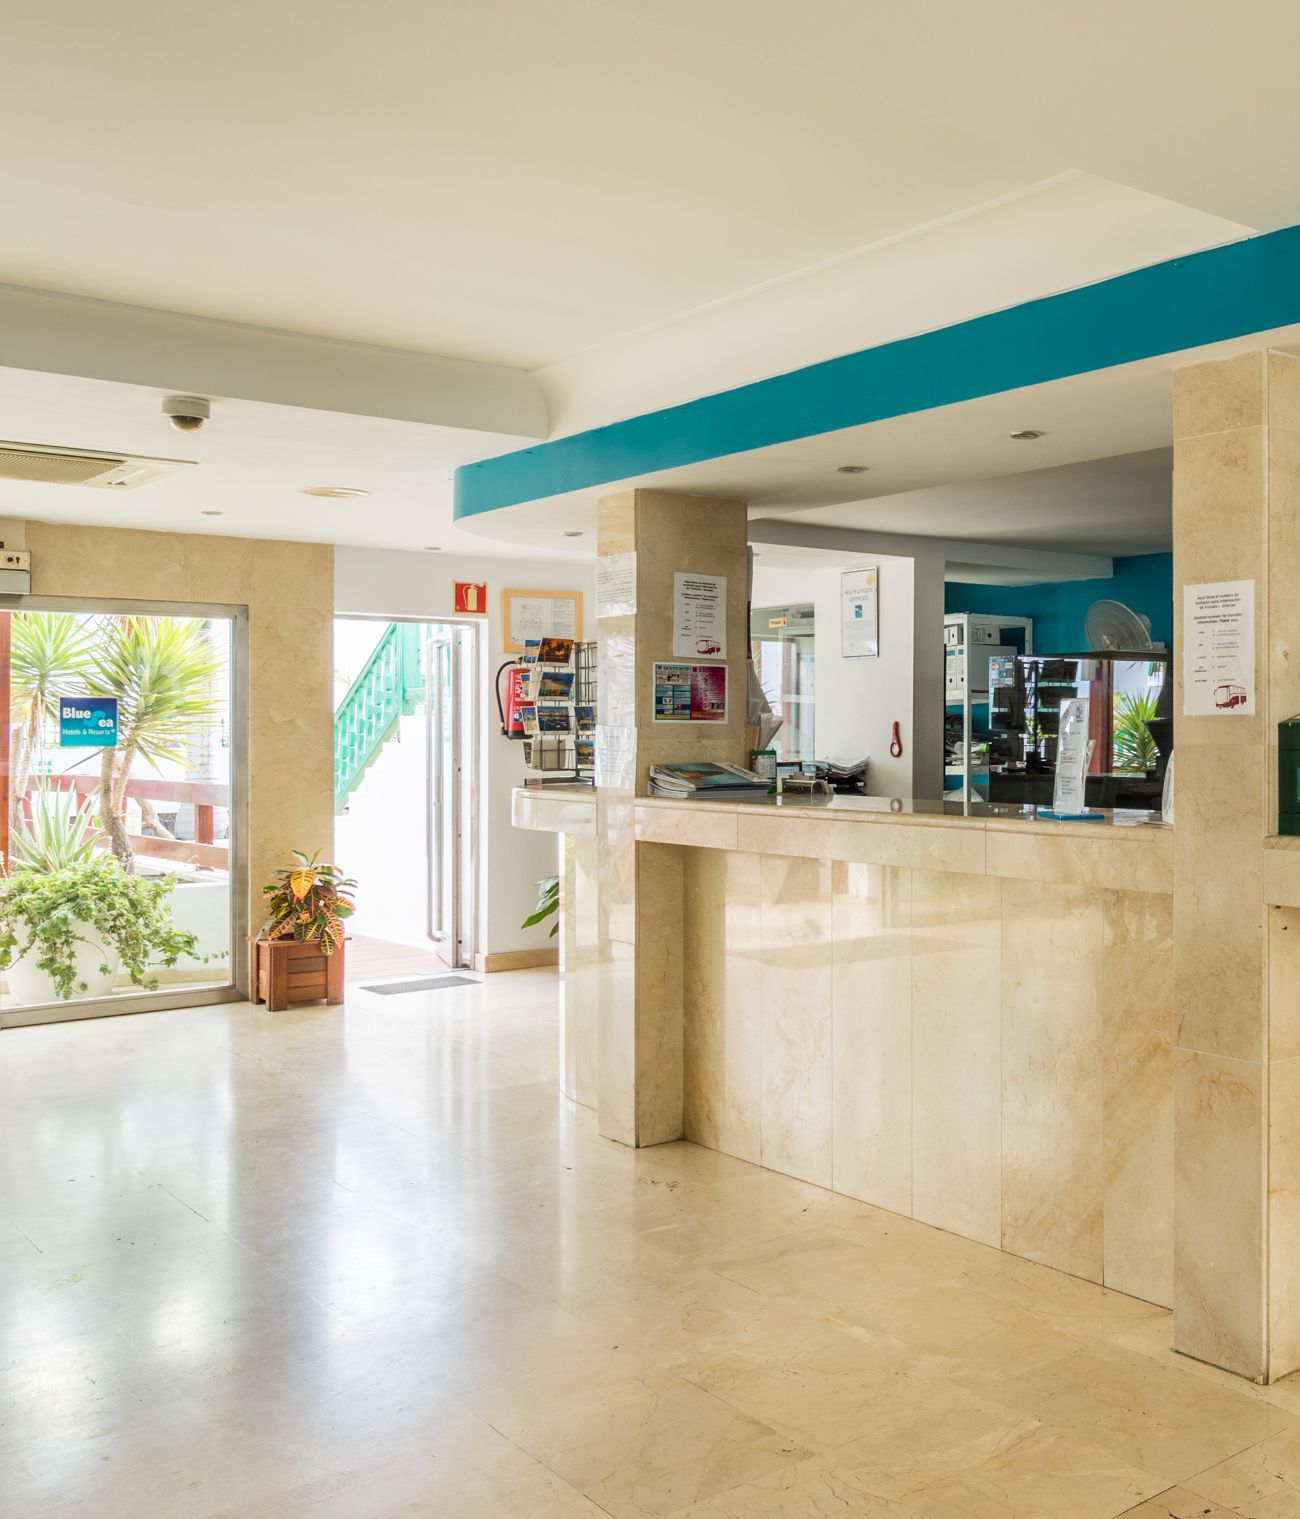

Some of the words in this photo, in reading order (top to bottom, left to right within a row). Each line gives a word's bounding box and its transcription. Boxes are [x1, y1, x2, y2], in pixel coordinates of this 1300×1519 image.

[62, 707, 92, 719] Blue
[62, 728, 82, 736] Hotels
[82, 728, 87, 736] &
